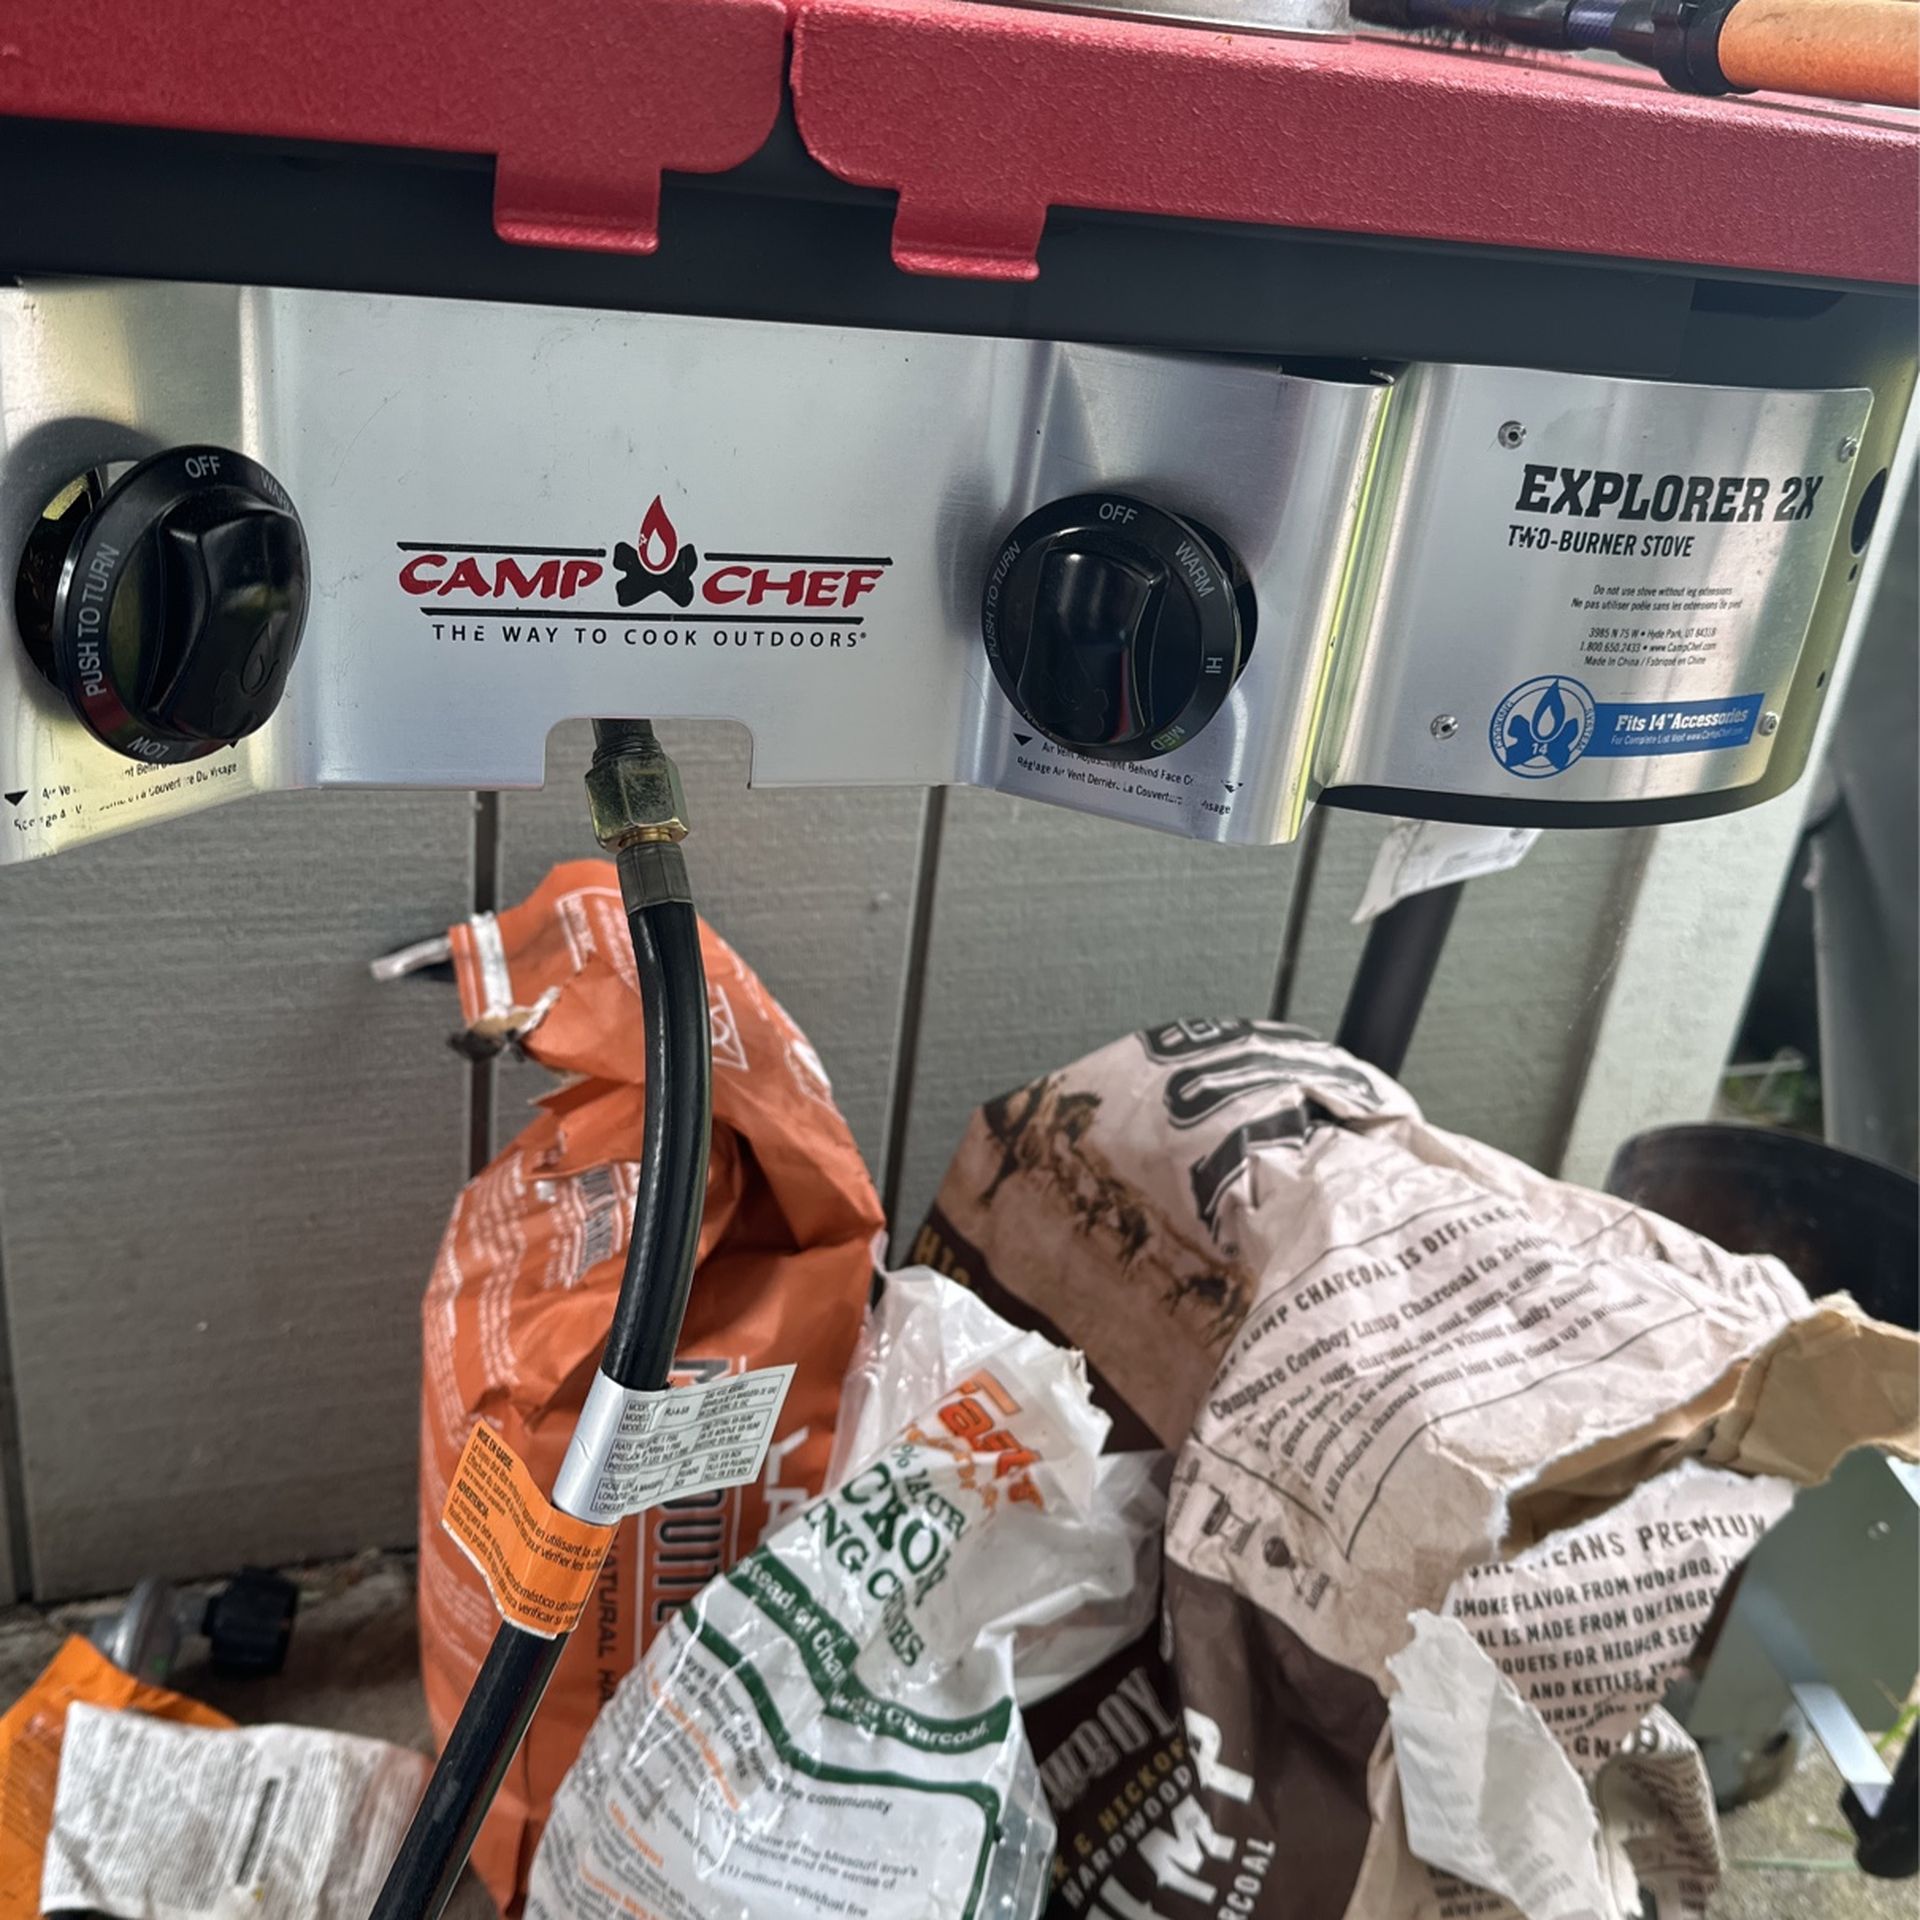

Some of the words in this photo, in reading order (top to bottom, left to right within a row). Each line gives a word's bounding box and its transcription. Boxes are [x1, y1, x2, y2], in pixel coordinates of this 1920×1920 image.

[185, 456, 221, 478] OFF
[1515, 464, 1770, 523] EXPLORER
[1773, 475, 1824, 523] 2X
[1099, 503, 1138, 525] OFF
[1507, 524, 1637, 556] TWO-BURNER
[1641, 535, 1695, 557] STOVE
[85, 542, 119, 607] TURN
[992, 541, 1022, 585] TURN
[1174, 541, 1216, 598] WARM
[399, 554, 603, 599] CAMP
[702, 566, 884, 608] CHEF
[1593, 584, 1605, 596] Do
[1607, 586, 1620, 596] not
[1621, 587, 1635, 596] use
[1637, 586, 1657, 596] stove
[1658, 586, 1685, 597] without
[987, 585, 999, 609] TO
[1584, 599, 1600, 611] pas
[1602, 599, 1629, 610] utiliser
[1653, 601, 1669, 610] sans
[1671, 600, 1682, 611] les
[78, 608, 100, 643] TO
[432, 624, 485, 643] THE
[502, 626, 559, 643] WAY
[575, 629, 606, 644] TO
[624, 629, 696, 645] COOK
[1611, 628, 1617, 638] N
[1631, 628, 1640, 638] W
[77, 643, 106, 696] PUSH
[1205, 657, 1223, 674] HI
[1584, 656, 1606, 667] Made
[1617, 656, 1639, 667] China
[1615, 713, 1646, 732] Fits
[127, 736, 170, 759] LOW
[1151, 725, 1184, 751] MED
[1531, 742, 1548, 755] 14
[1611, 735, 1622, 746] For
[1623, 734, 1656, 746] Complete
[1067, 768, 1087, 783] Vent
[1128, 761, 1158, 779] Behind
[1160, 768, 1181, 785] Face
[1294, 1259, 1397, 1311] CHARCOAL
[1395, 1246, 1422, 1271] IS
[1209, 1367, 1287, 1420] Compare
[1286, 1328, 1350, 1374] Cowboy
[1351, 1312, 1399, 1340] Lump
[1400, 1265, 1479, 1320] Charcoal
[1477, 1254, 1499, 1274] to
[1453, 1595, 1509, 1618] SMOKE
[1512, 1583, 1579, 1613] FLAVOR
[1580, 1575, 1629, 1601] FROM
[1502, 1628, 1521, 1646] IS
[1526, 1618, 1575, 1643] MADE
[1579, 1609, 1628, 1634] FROM
[1502, 1652, 1557, 1674] QUETS
[1564, 1649, 1599, 1669] FOR
[1530, 1681, 1566, 1699] AND
[807, 1793, 893, 1815] community
[1062, 1765, 1193, 1908] HARDWOOD
[817, 1860, 838, 1876] the
[823, 1849, 878, 1871] Missouri
